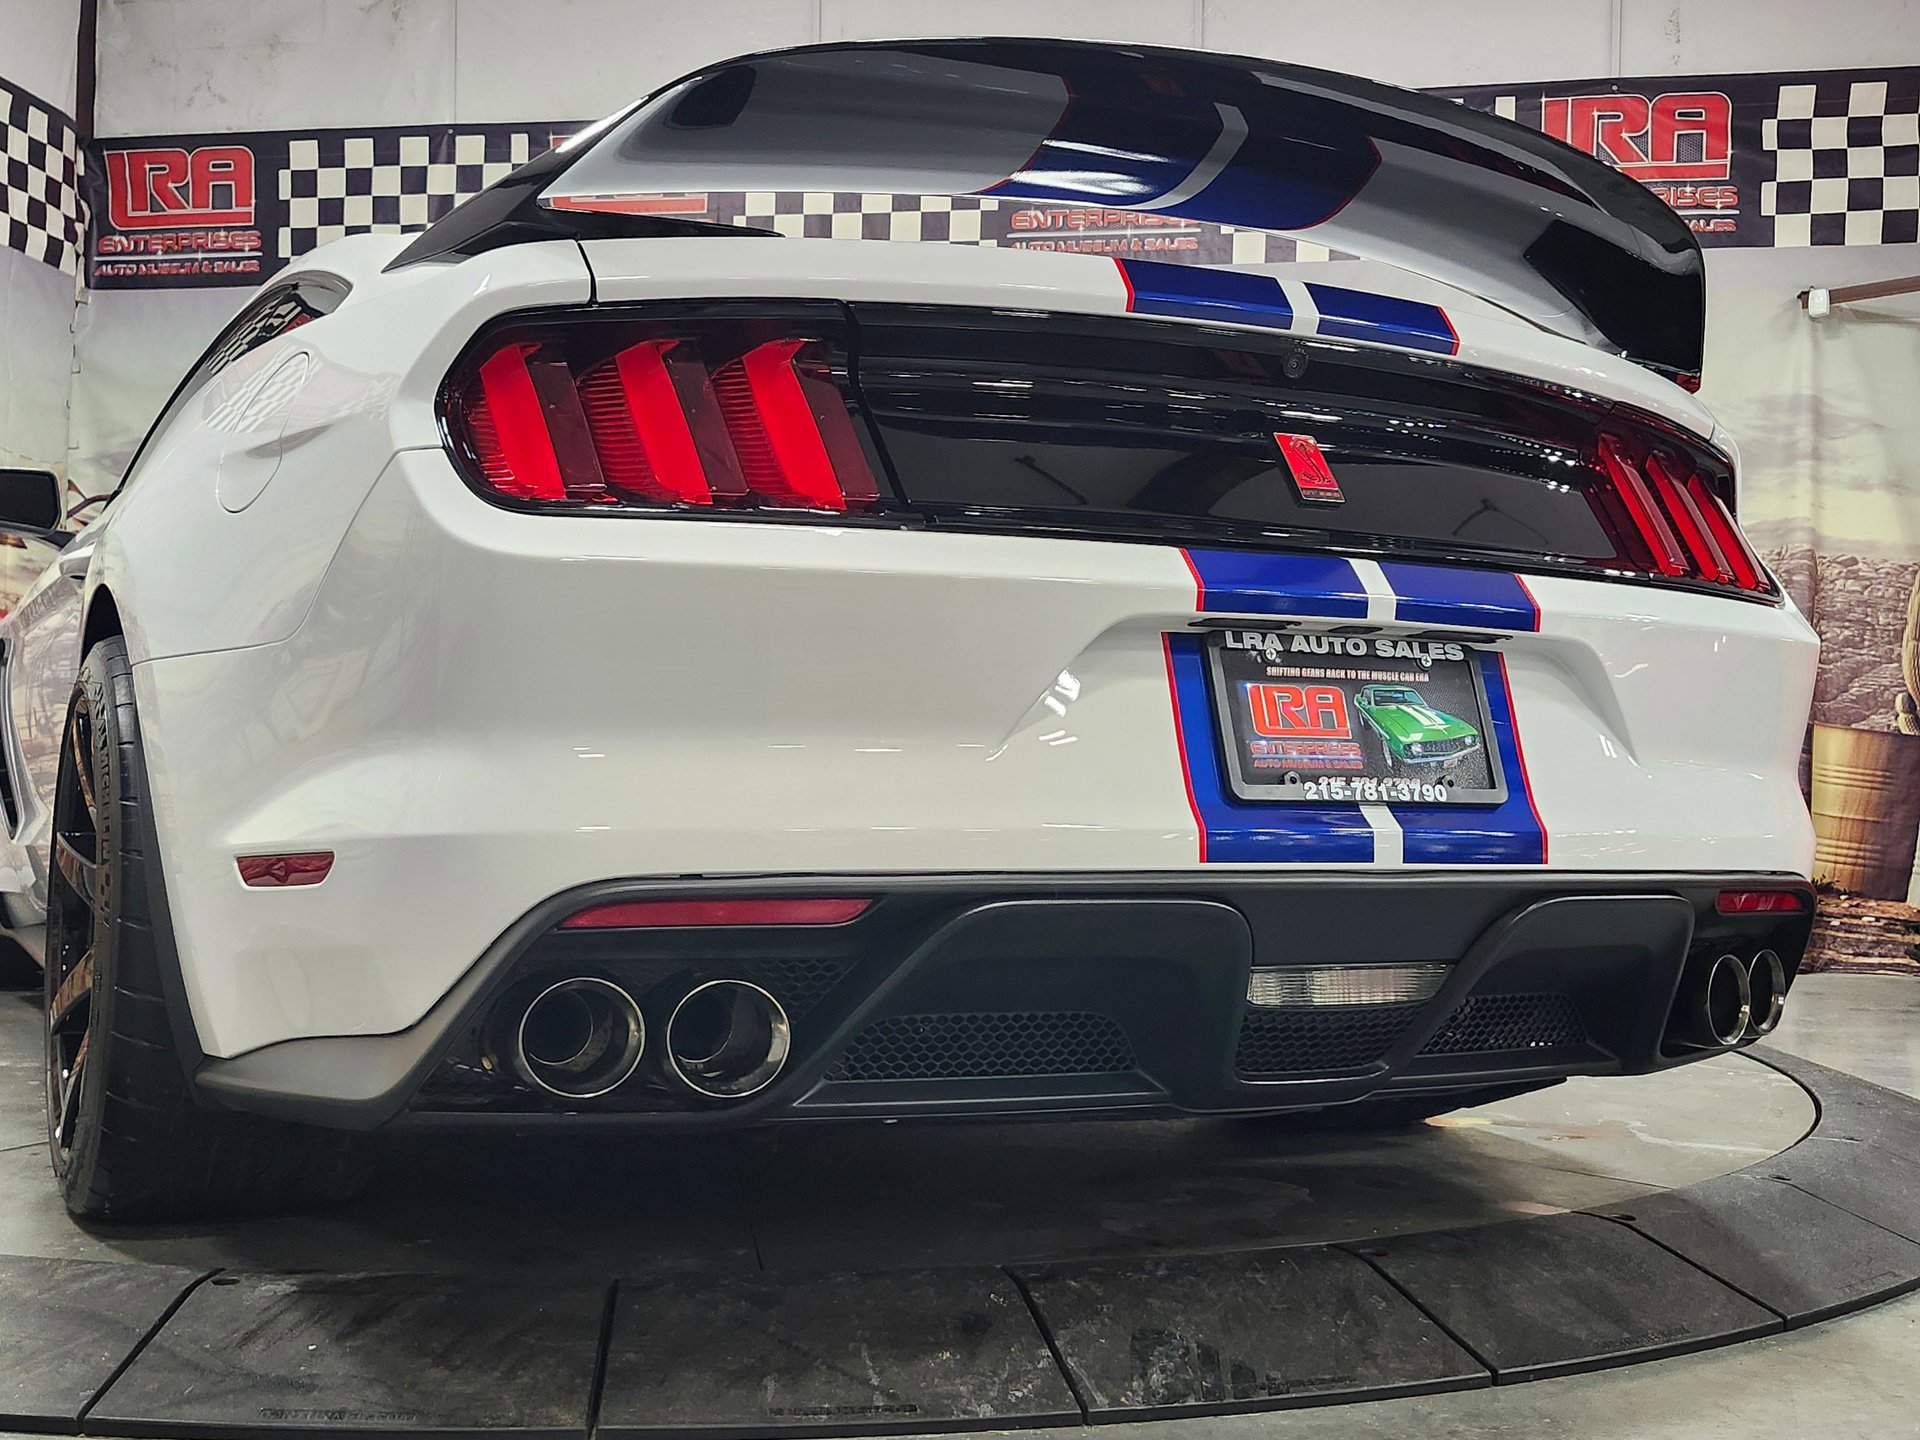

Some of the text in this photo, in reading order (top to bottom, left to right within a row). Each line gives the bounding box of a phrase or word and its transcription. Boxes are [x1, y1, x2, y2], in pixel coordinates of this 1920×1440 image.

[1542, 91, 1733, 182] LRA
[104, 146, 255, 230] LRA
[1683, 219, 1736, 232] ALES
[98, 231, 262, 253] ENTERPRISES
[1056, 239, 1128, 252] MUSEUM
[1130, 238, 1142, 251] &
[1144, 238, 1198, 250] SALES
[95, 263, 137, 277] AUTO
[201, 260, 212, 273] &
[214, 260, 260, 272] SALES
[1225, 631, 1464, 661] LRA AUTO SALES
[1266, 666, 1430, 683] SHIFTING GEARS BACK TO THE MUSCLE CAR ERA
[1247, 684, 1352, 739] LRA
[1250, 741, 1362, 757] ENTERPRISES
[1303, 782, 1448, 801] 215-781-3790
